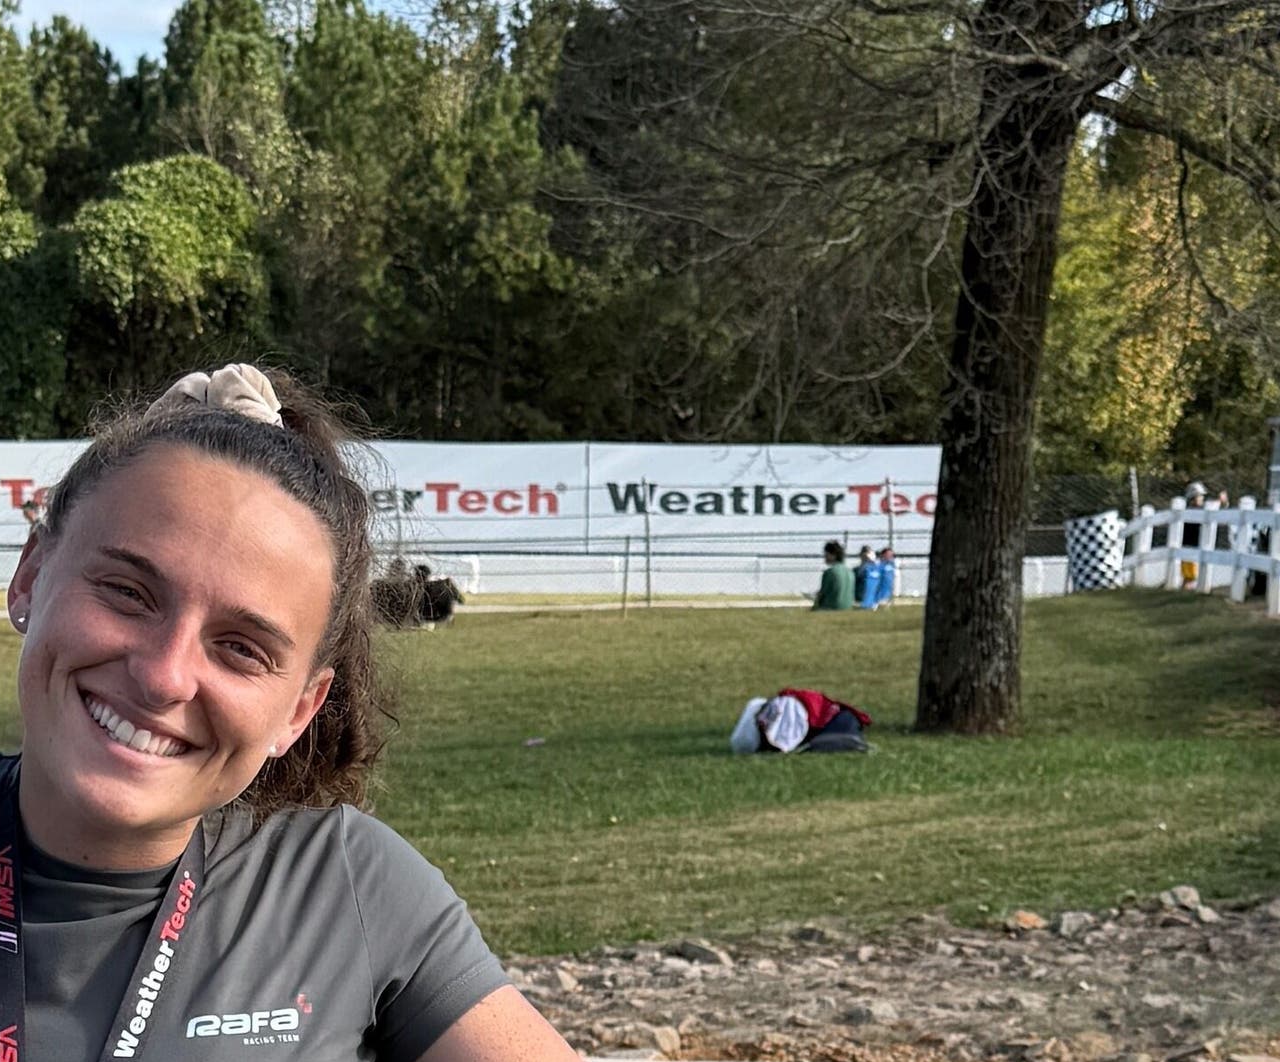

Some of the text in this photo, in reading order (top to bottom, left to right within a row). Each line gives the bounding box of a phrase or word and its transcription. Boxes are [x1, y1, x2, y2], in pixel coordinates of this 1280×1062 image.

[606, 482, 938, 517] WeatherTec
[243, 1034, 300, 1046] RACING TEAM
